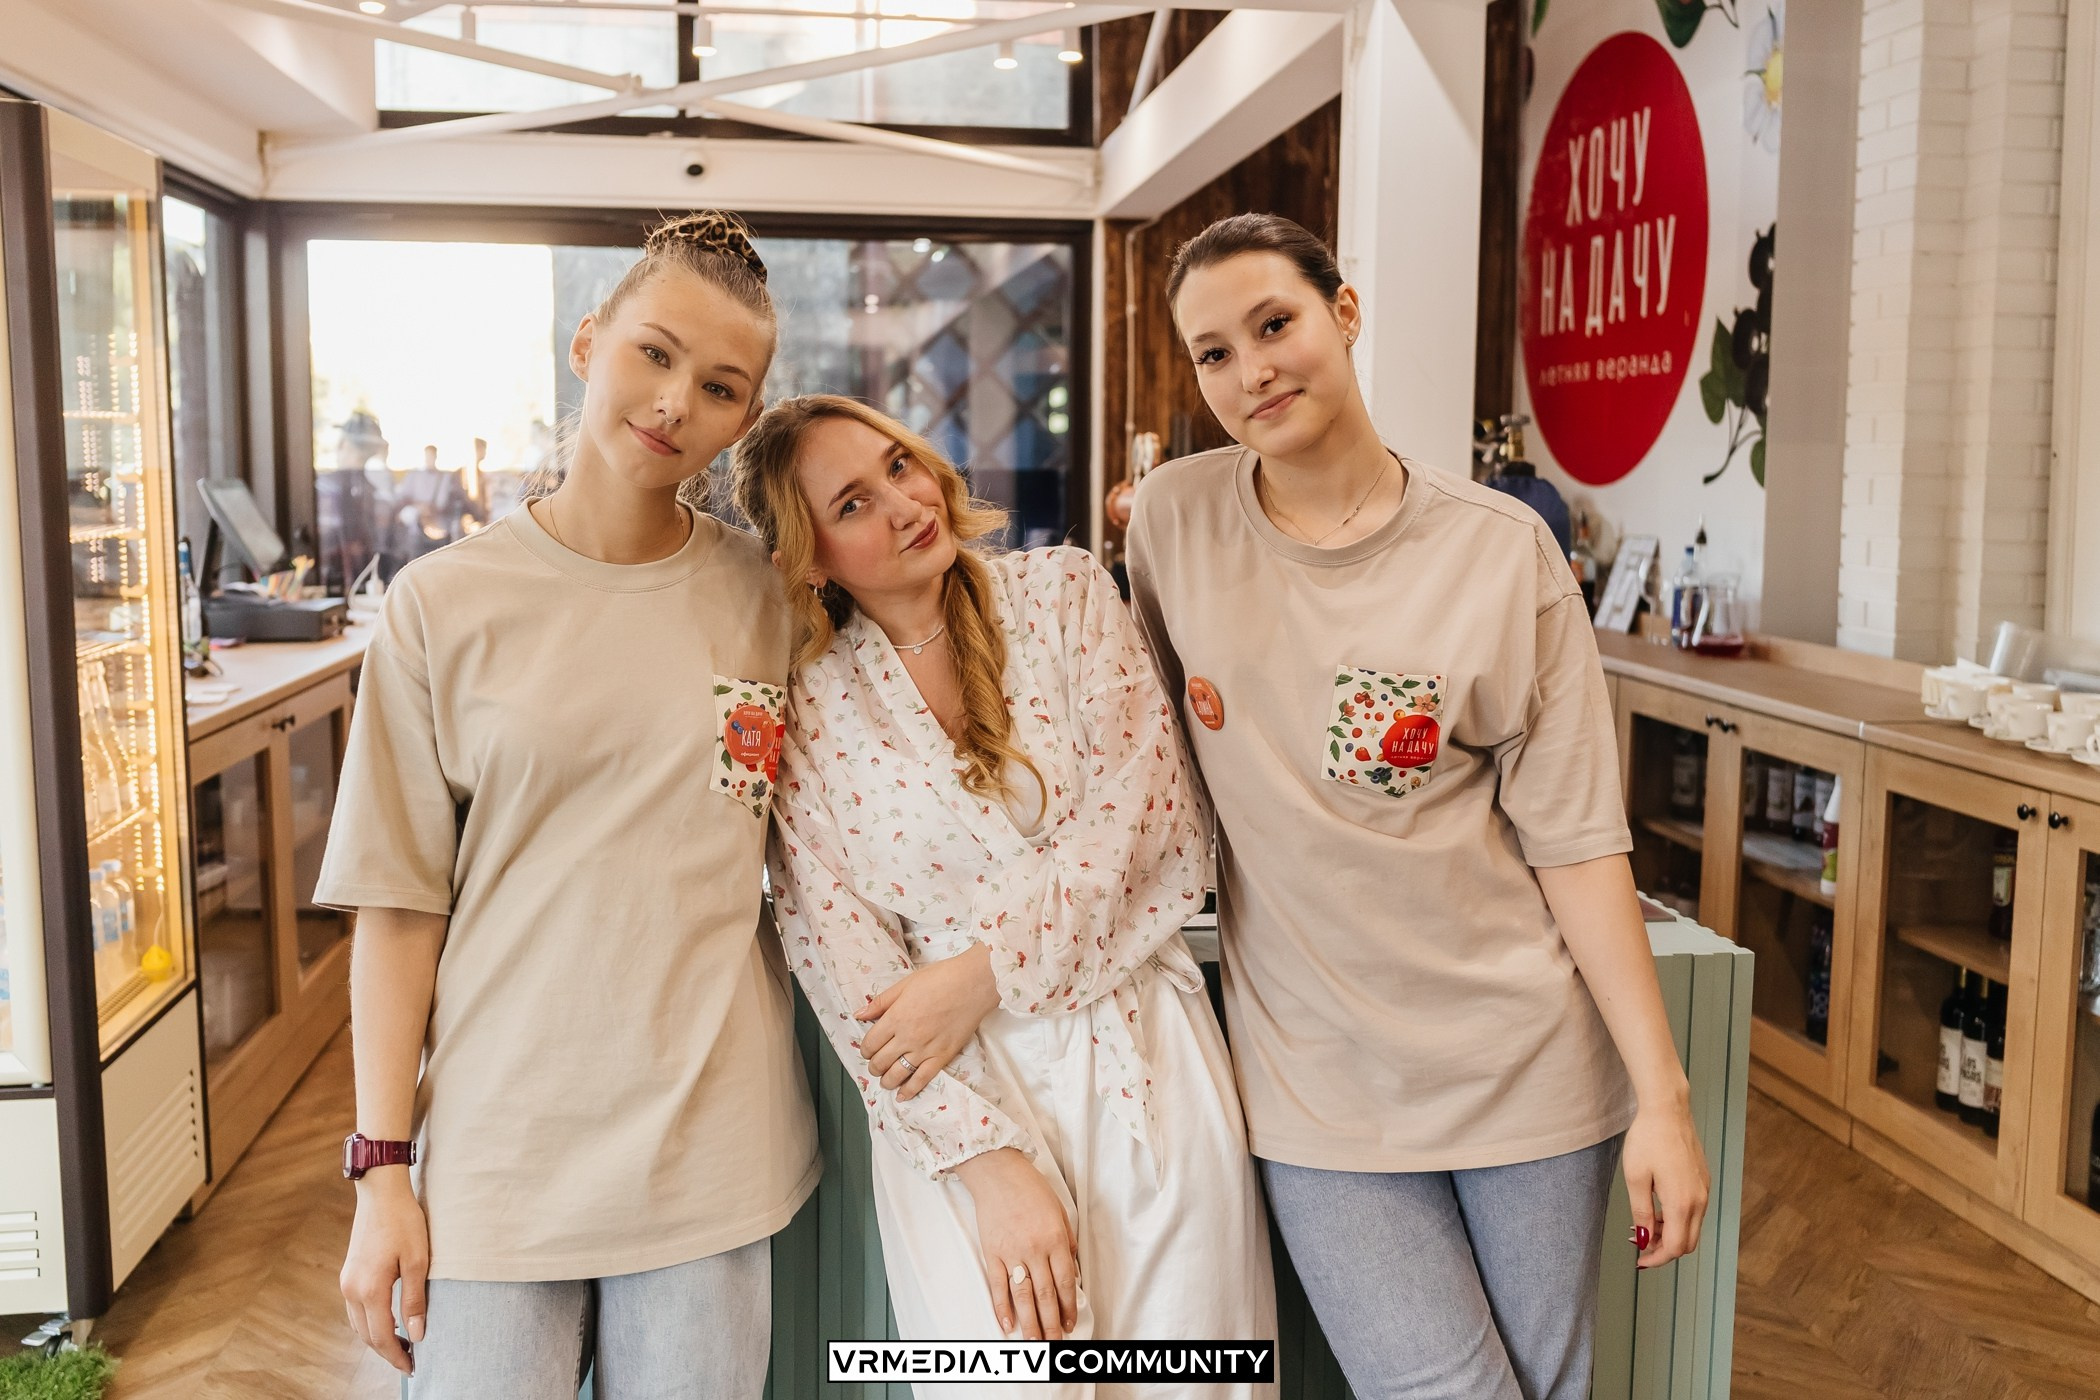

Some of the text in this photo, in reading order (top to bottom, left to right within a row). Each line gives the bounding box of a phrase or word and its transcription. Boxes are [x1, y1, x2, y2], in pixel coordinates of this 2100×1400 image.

[1565, 106, 1651, 227] ХОЧУ
[1540, 214, 1677, 339] НА ДАЧУ
[1539, 350, 1672, 387] летняя веранда
[741, 730, 761, 747] КАТЯ
[1402, 727, 1429, 740] ХОЧУ
[1391, 740, 1435, 755] НА ДАЧУ
